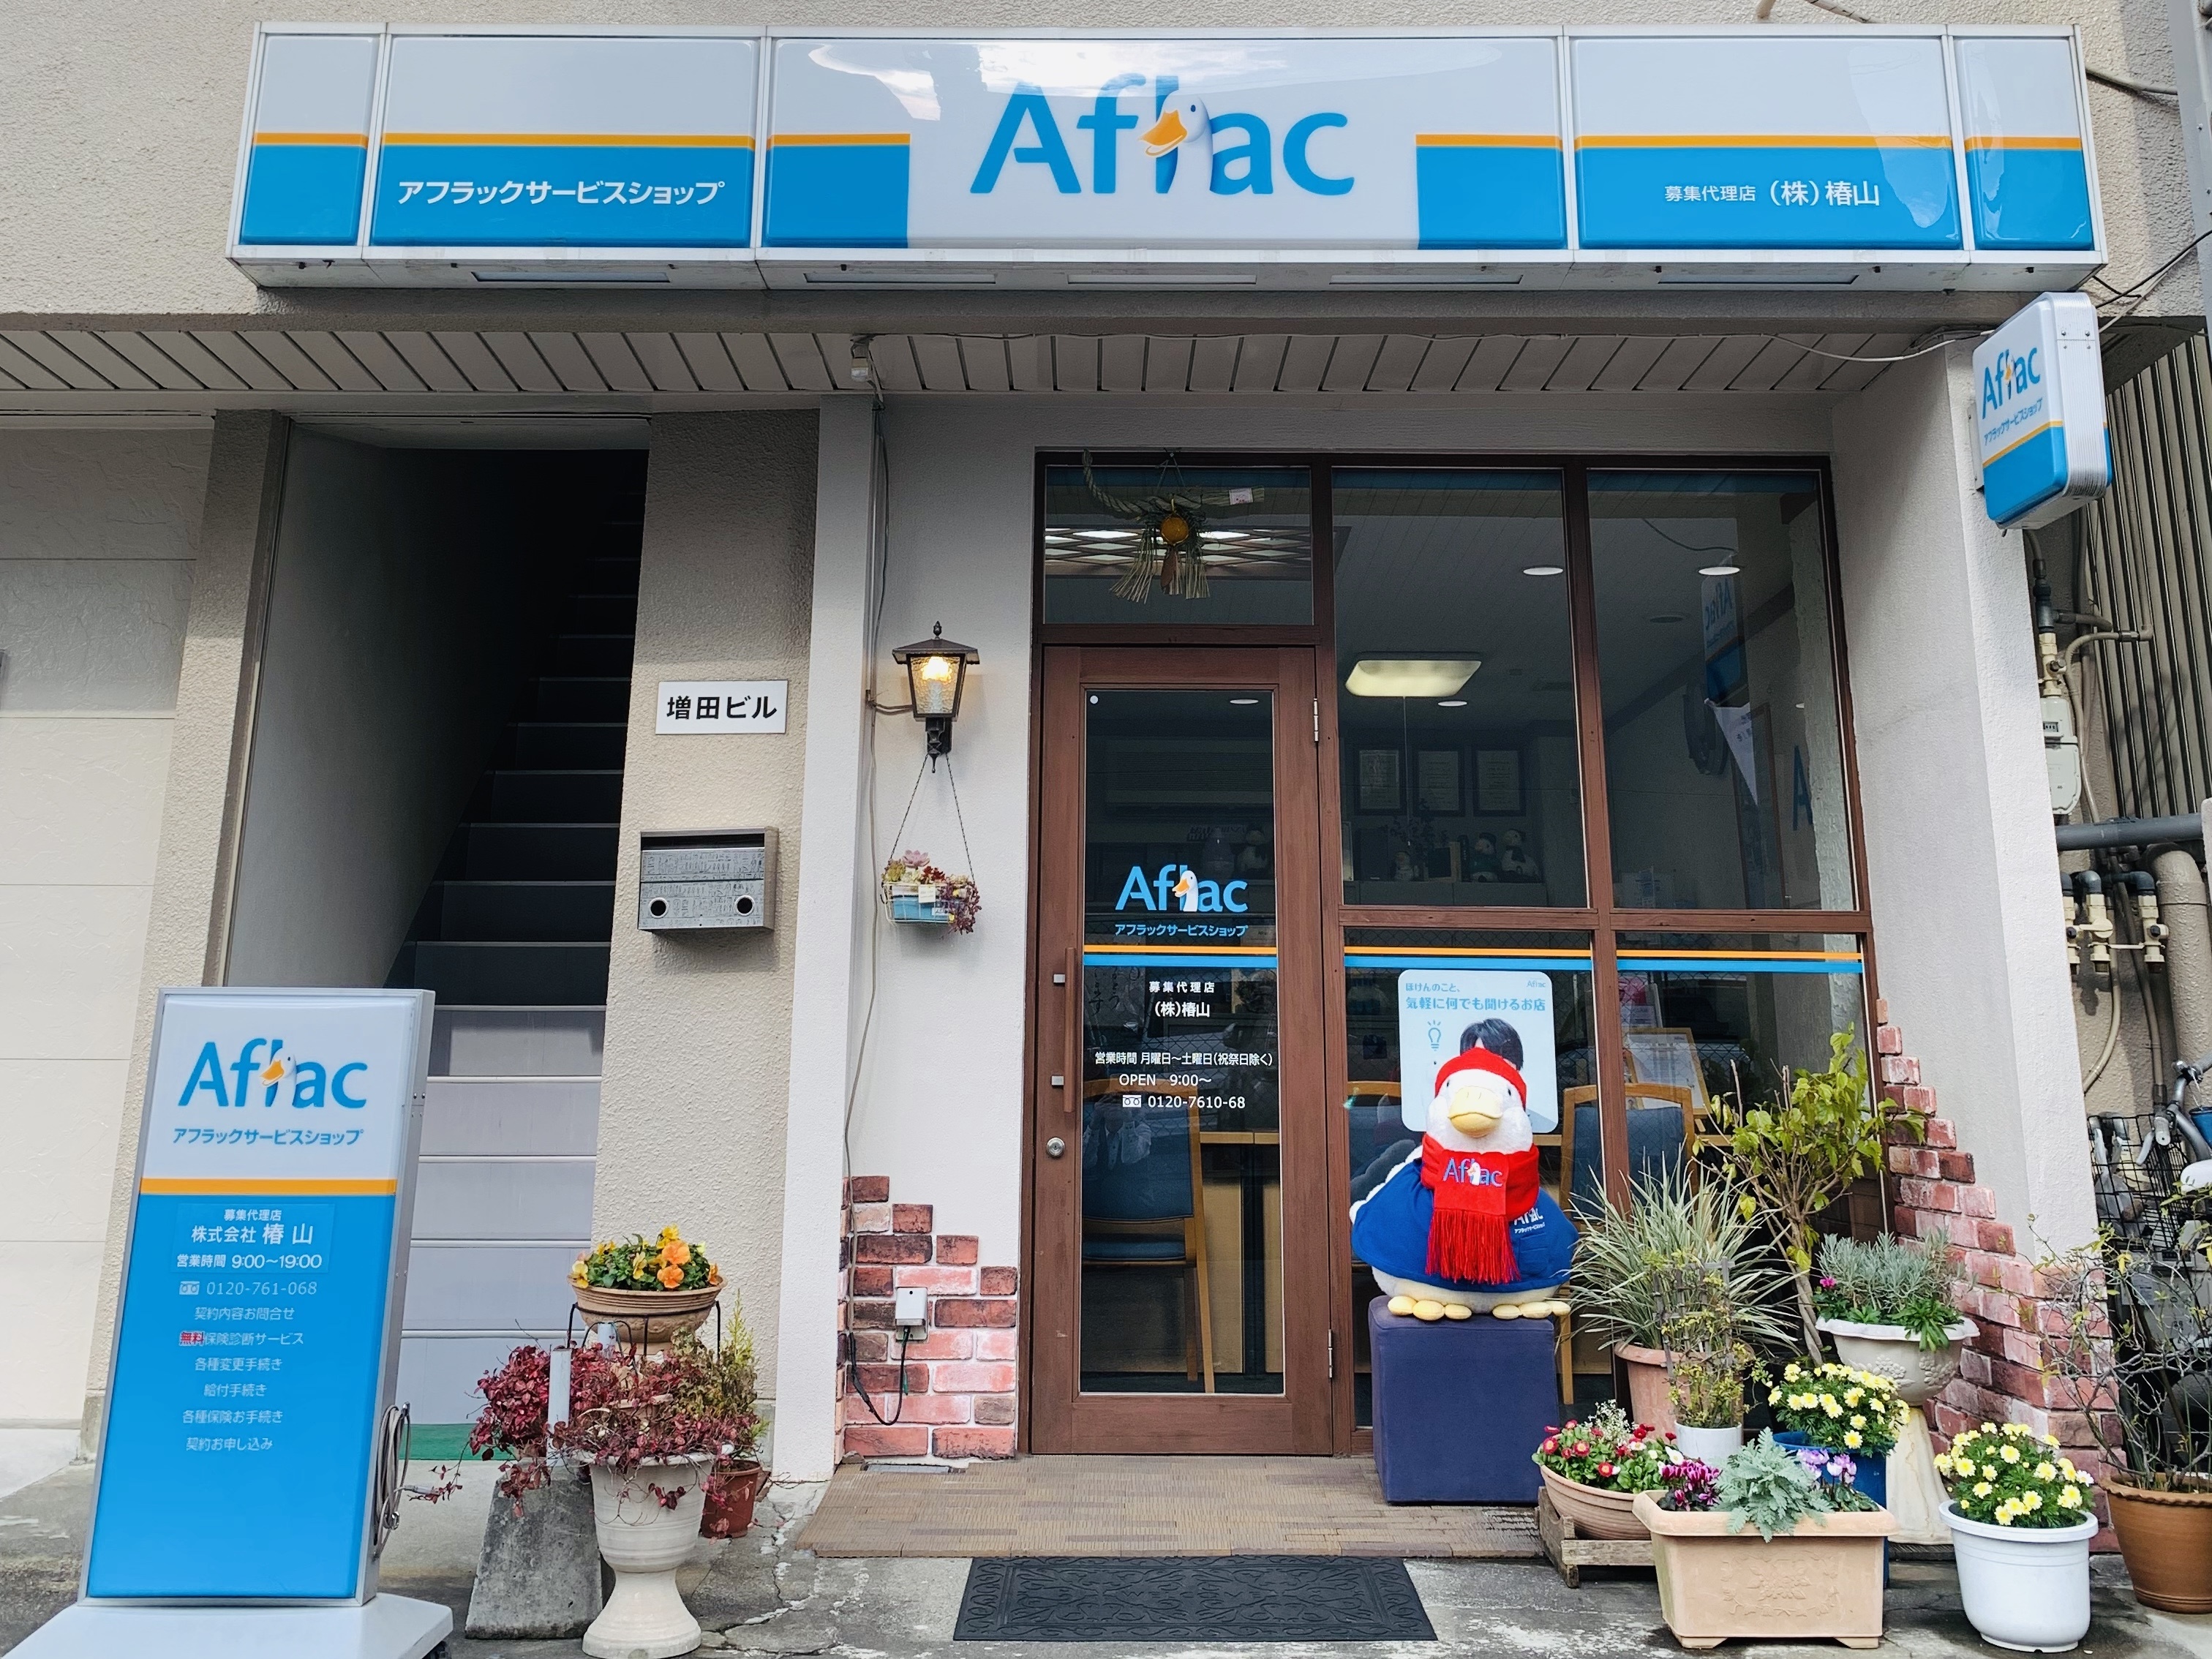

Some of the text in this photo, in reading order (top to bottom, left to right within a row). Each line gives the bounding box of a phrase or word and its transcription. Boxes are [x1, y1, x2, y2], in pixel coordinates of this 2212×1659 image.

[969, 73, 1355, 195] Aflac
[397, 180, 725, 206] アフラックサービスショップ
[1664, 185, 1756, 203] 募集代理店
[1982, 347, 2041, 419] Aflac
[666, 695, 778, 721] 増田ビル
[1115, 864, 1249, 912] Aflac
[1115, 924, 1249, 937] アフラックサービスショップ
[1148, 981, 1215, 994] 募集代理店
[1405, 982, 1461, 993] ほけんのこと、
[1405, 997, 1546, 1012] 気軽に何でも聞けるお店
[1094, 1052, 1137, 1065] 営業時間
[177, 1037, 368, 1109] Aflac
[1119, 1074, 1156, 1086] OPEN
[1148, 1096, 1246, 1109] 0120-7610-68
[173, 1128, 364, 1146] アフラックサービスショップ
[1442, 1158, 1503, 1187] Aflac
[224, 1209, 282, 1222] 募集代理店
[191, 1225, 257, 1244] 株式会社
[176, 1254, 226, 1268] 営業時間
[206, 1281, 317, 1295] 0120-761-068
[195, 1306, 295, 1321] 契約内容お問合せ
[195, 1357, 282, 1372] 各種変更手続き
[203, 1383, 267, 1397] 給付手続き
[182, 1410, 283, 1424] 各種保険お手続き
[186, 1437, 273, 1451] 契約お申し込み
